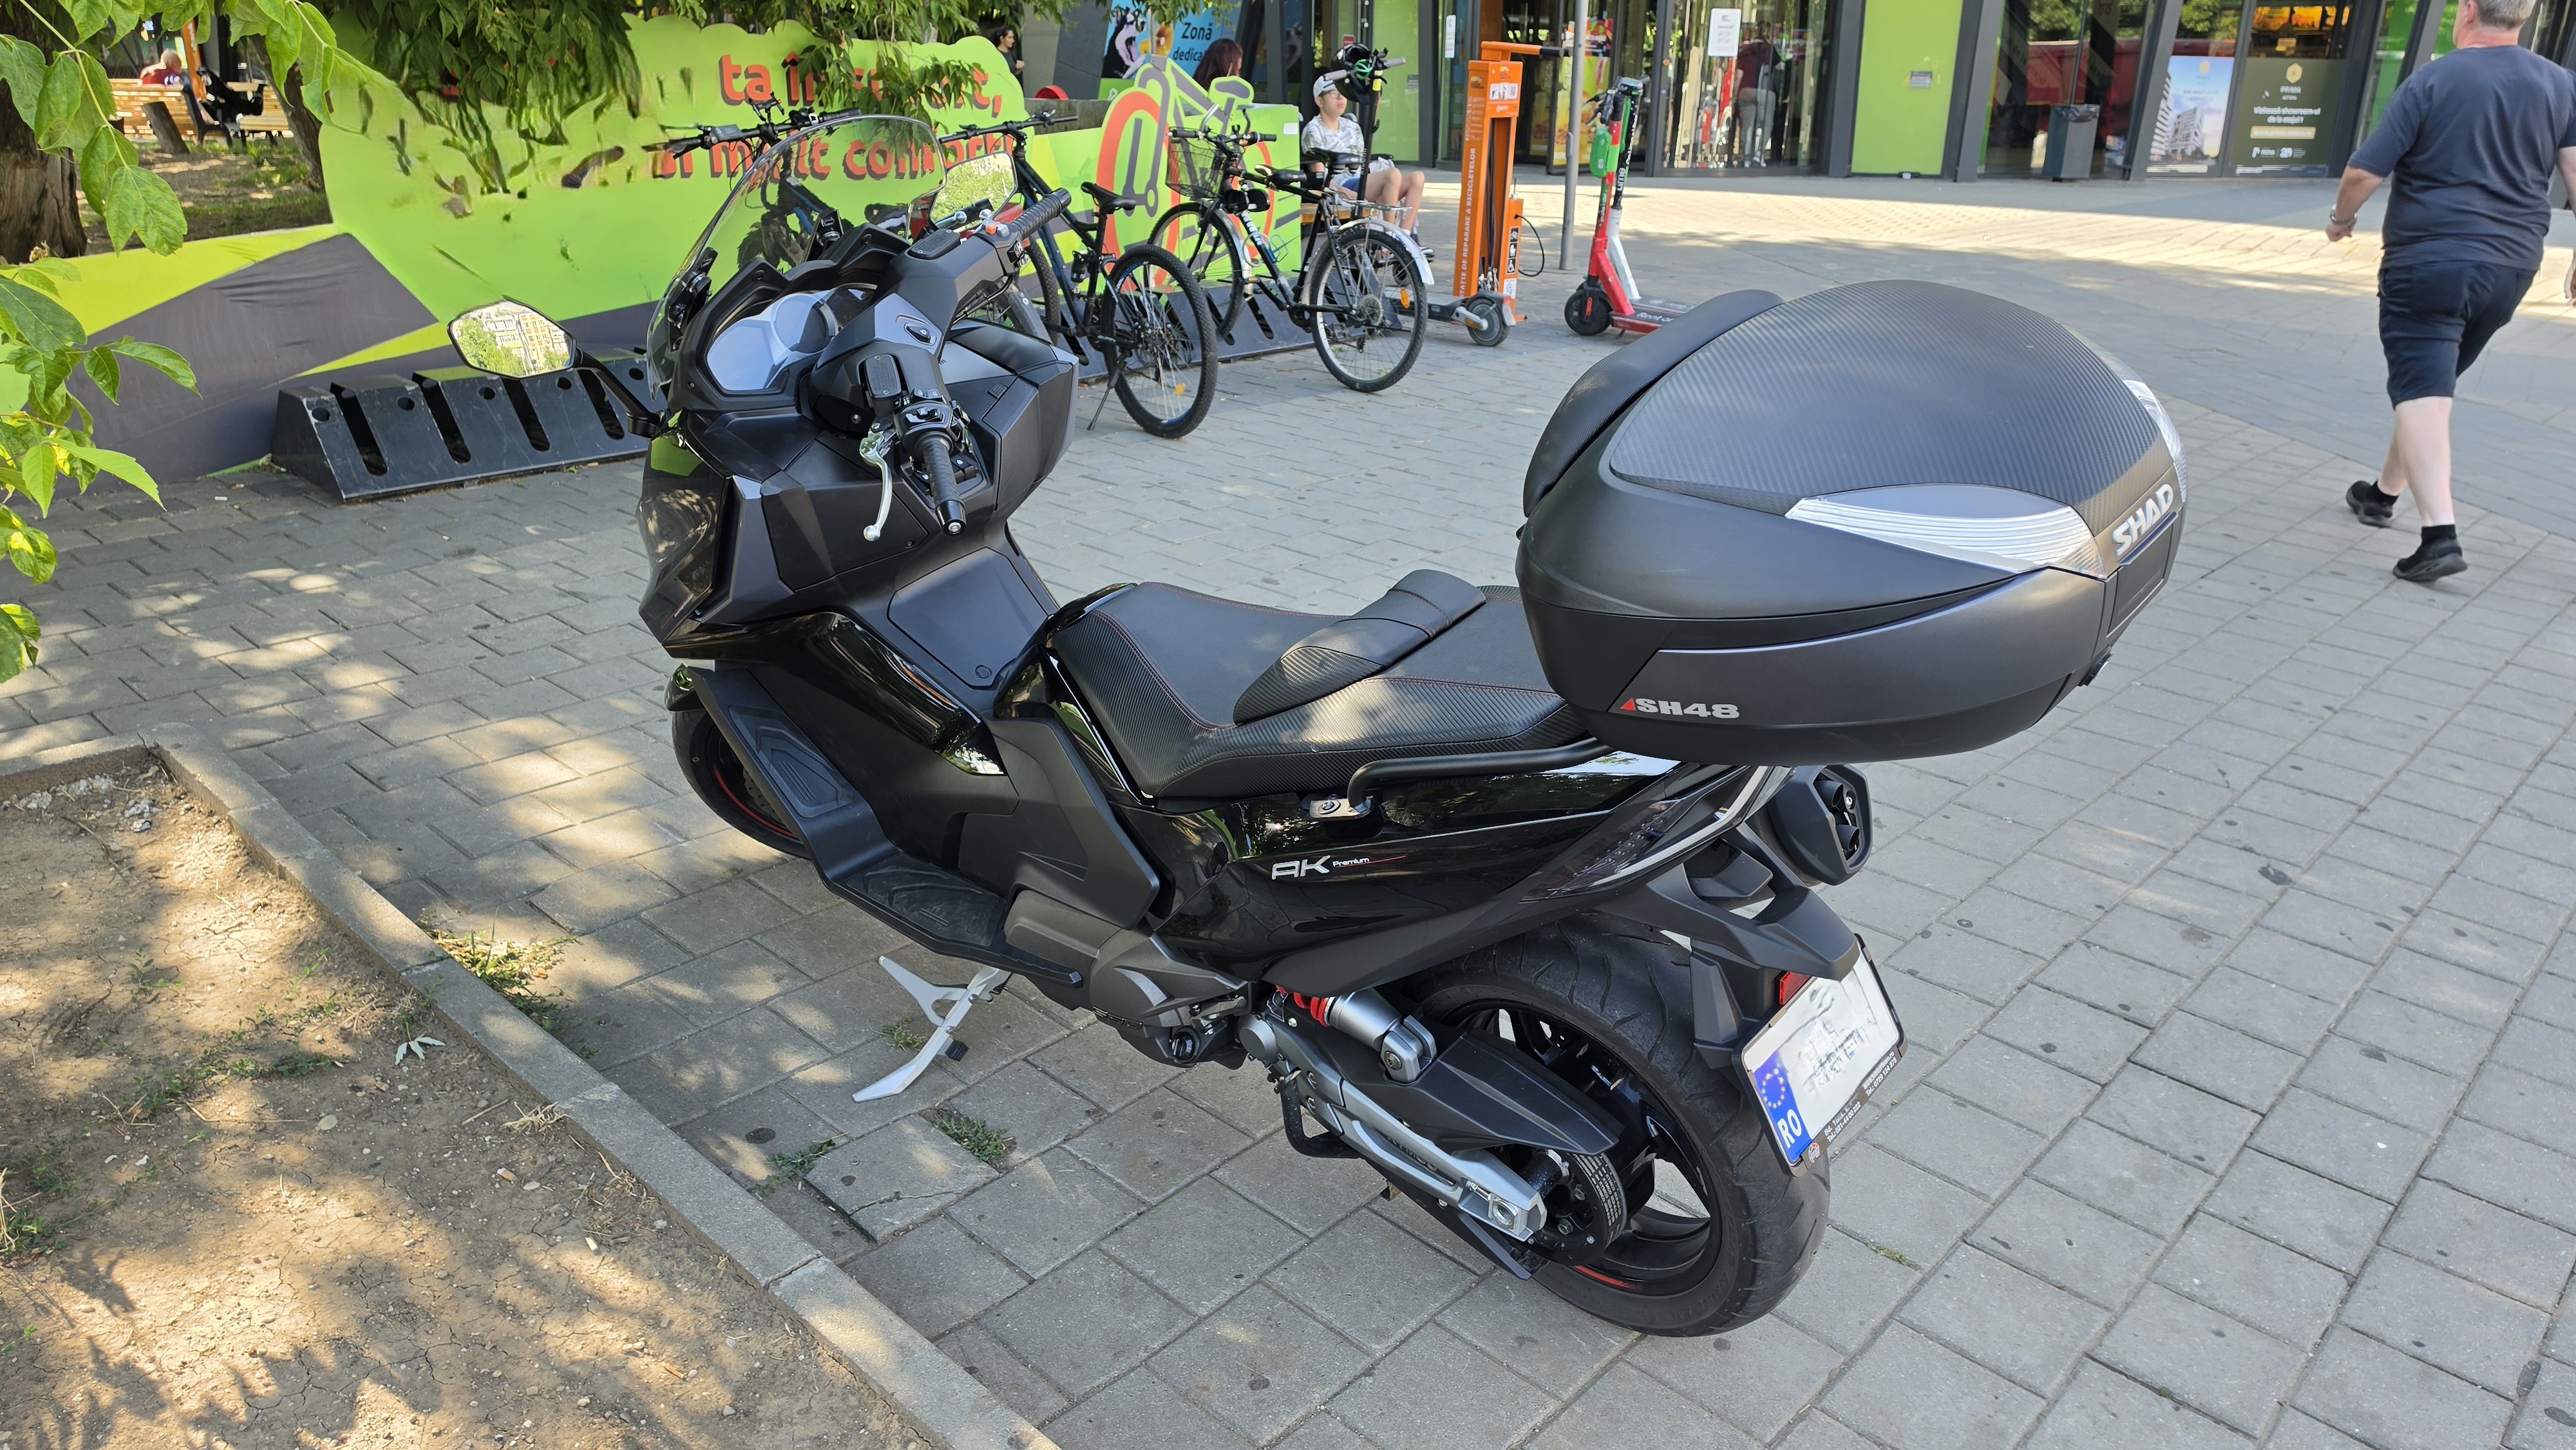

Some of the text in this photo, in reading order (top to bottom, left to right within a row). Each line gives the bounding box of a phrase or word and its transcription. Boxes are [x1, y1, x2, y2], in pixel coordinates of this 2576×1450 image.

[1181, 22, 1213, 41] Zonă
[1173, 46, 1207, 61] dedica
[719, 54, 773, 106] ta
[1466, 147, 1477, 206] BICICLETELOR
[1463, 216, 1472, 254] REPARARE
[1461, 256, 1469, 267] DE
[2112, 484, 2174, 556] SHAD
[1635, 698, 1740, 719] SH48
[1271, 855, 1370, 880] AK Premium
[1777, 1109, 1802, 1149] RO
